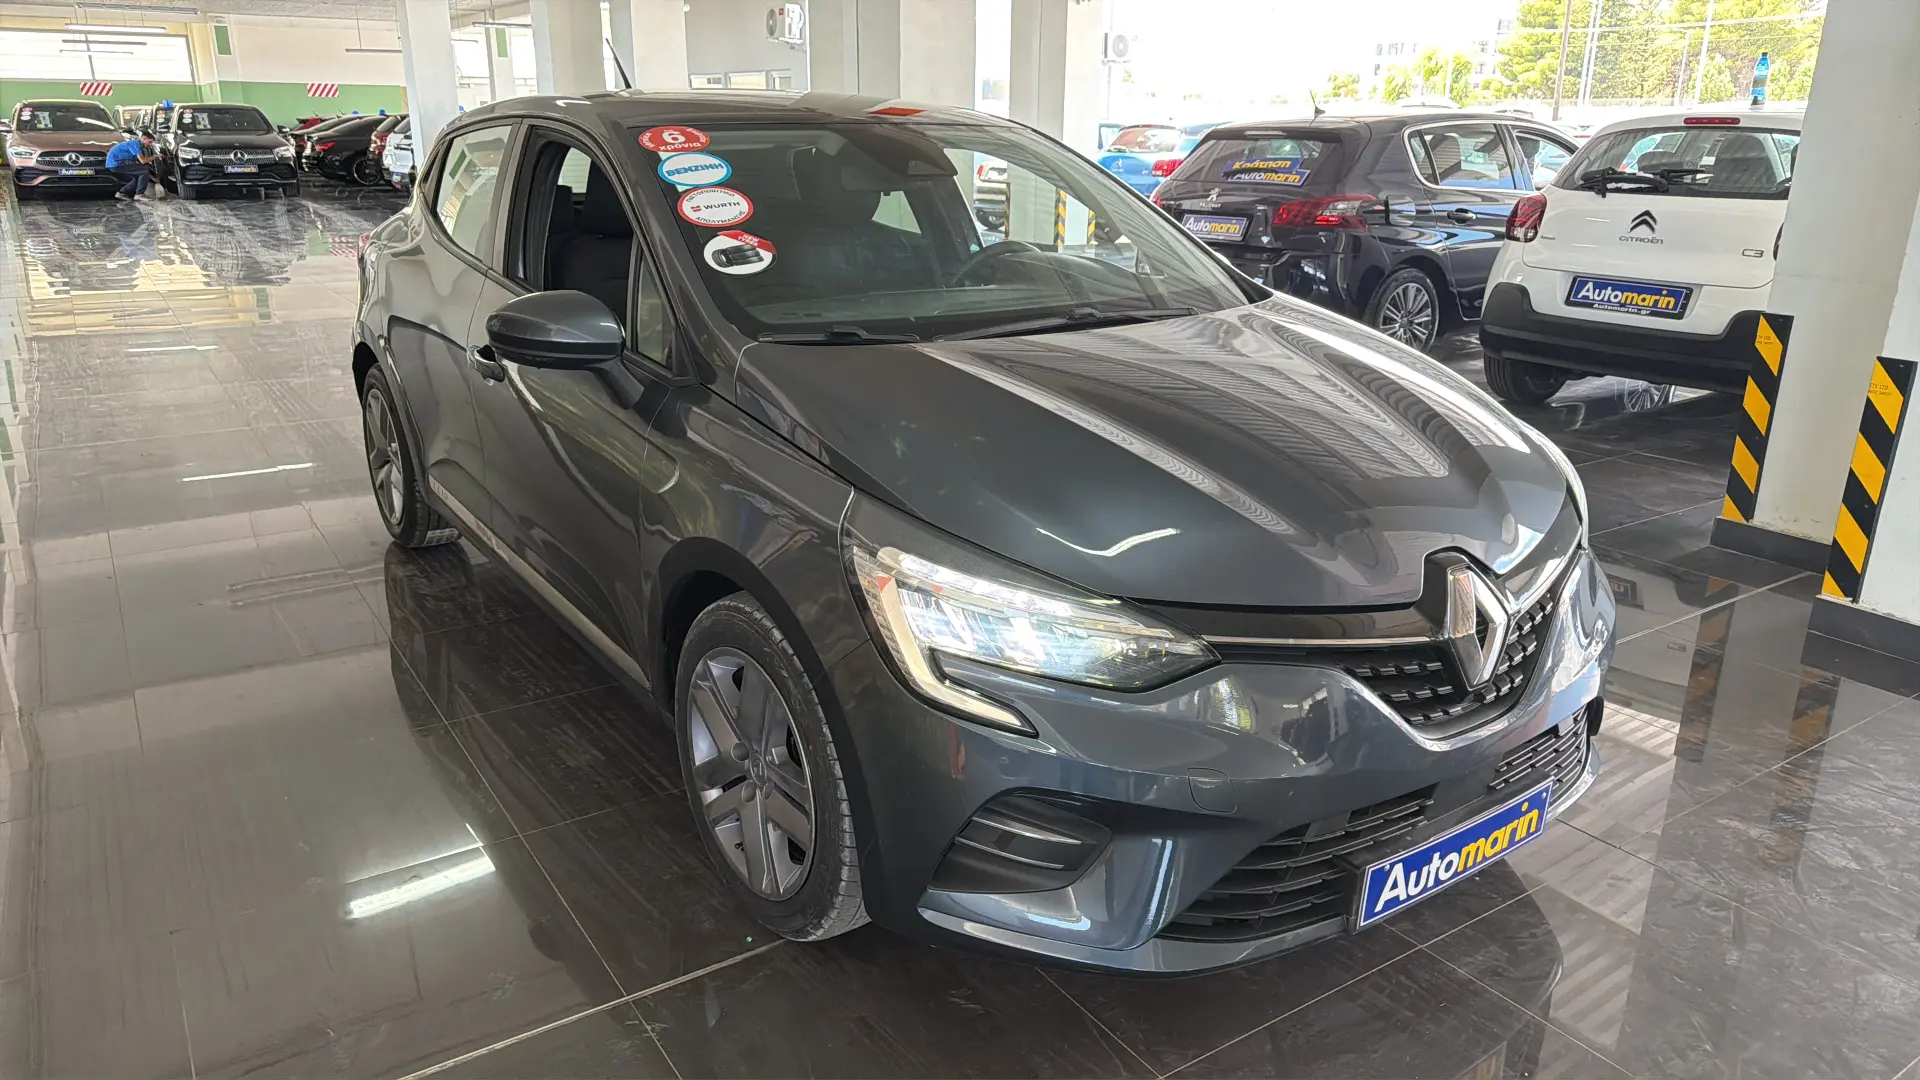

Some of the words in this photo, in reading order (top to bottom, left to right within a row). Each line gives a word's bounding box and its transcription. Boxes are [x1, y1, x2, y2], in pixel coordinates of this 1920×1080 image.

[662, 131, 686, 144] 6
[659, 142, 702, 151] χρόνια
[1233, 170, 1301, 183] Automarin
[1185, 217, 1240, 234] Automarin
[1741, 248, 1765, 259] C3
[1577, 281, 1676, 310] Automarin
[1592, 303, 1652, 315] Automarin.gr
[1373, 801, 1539, 913] Automarin
